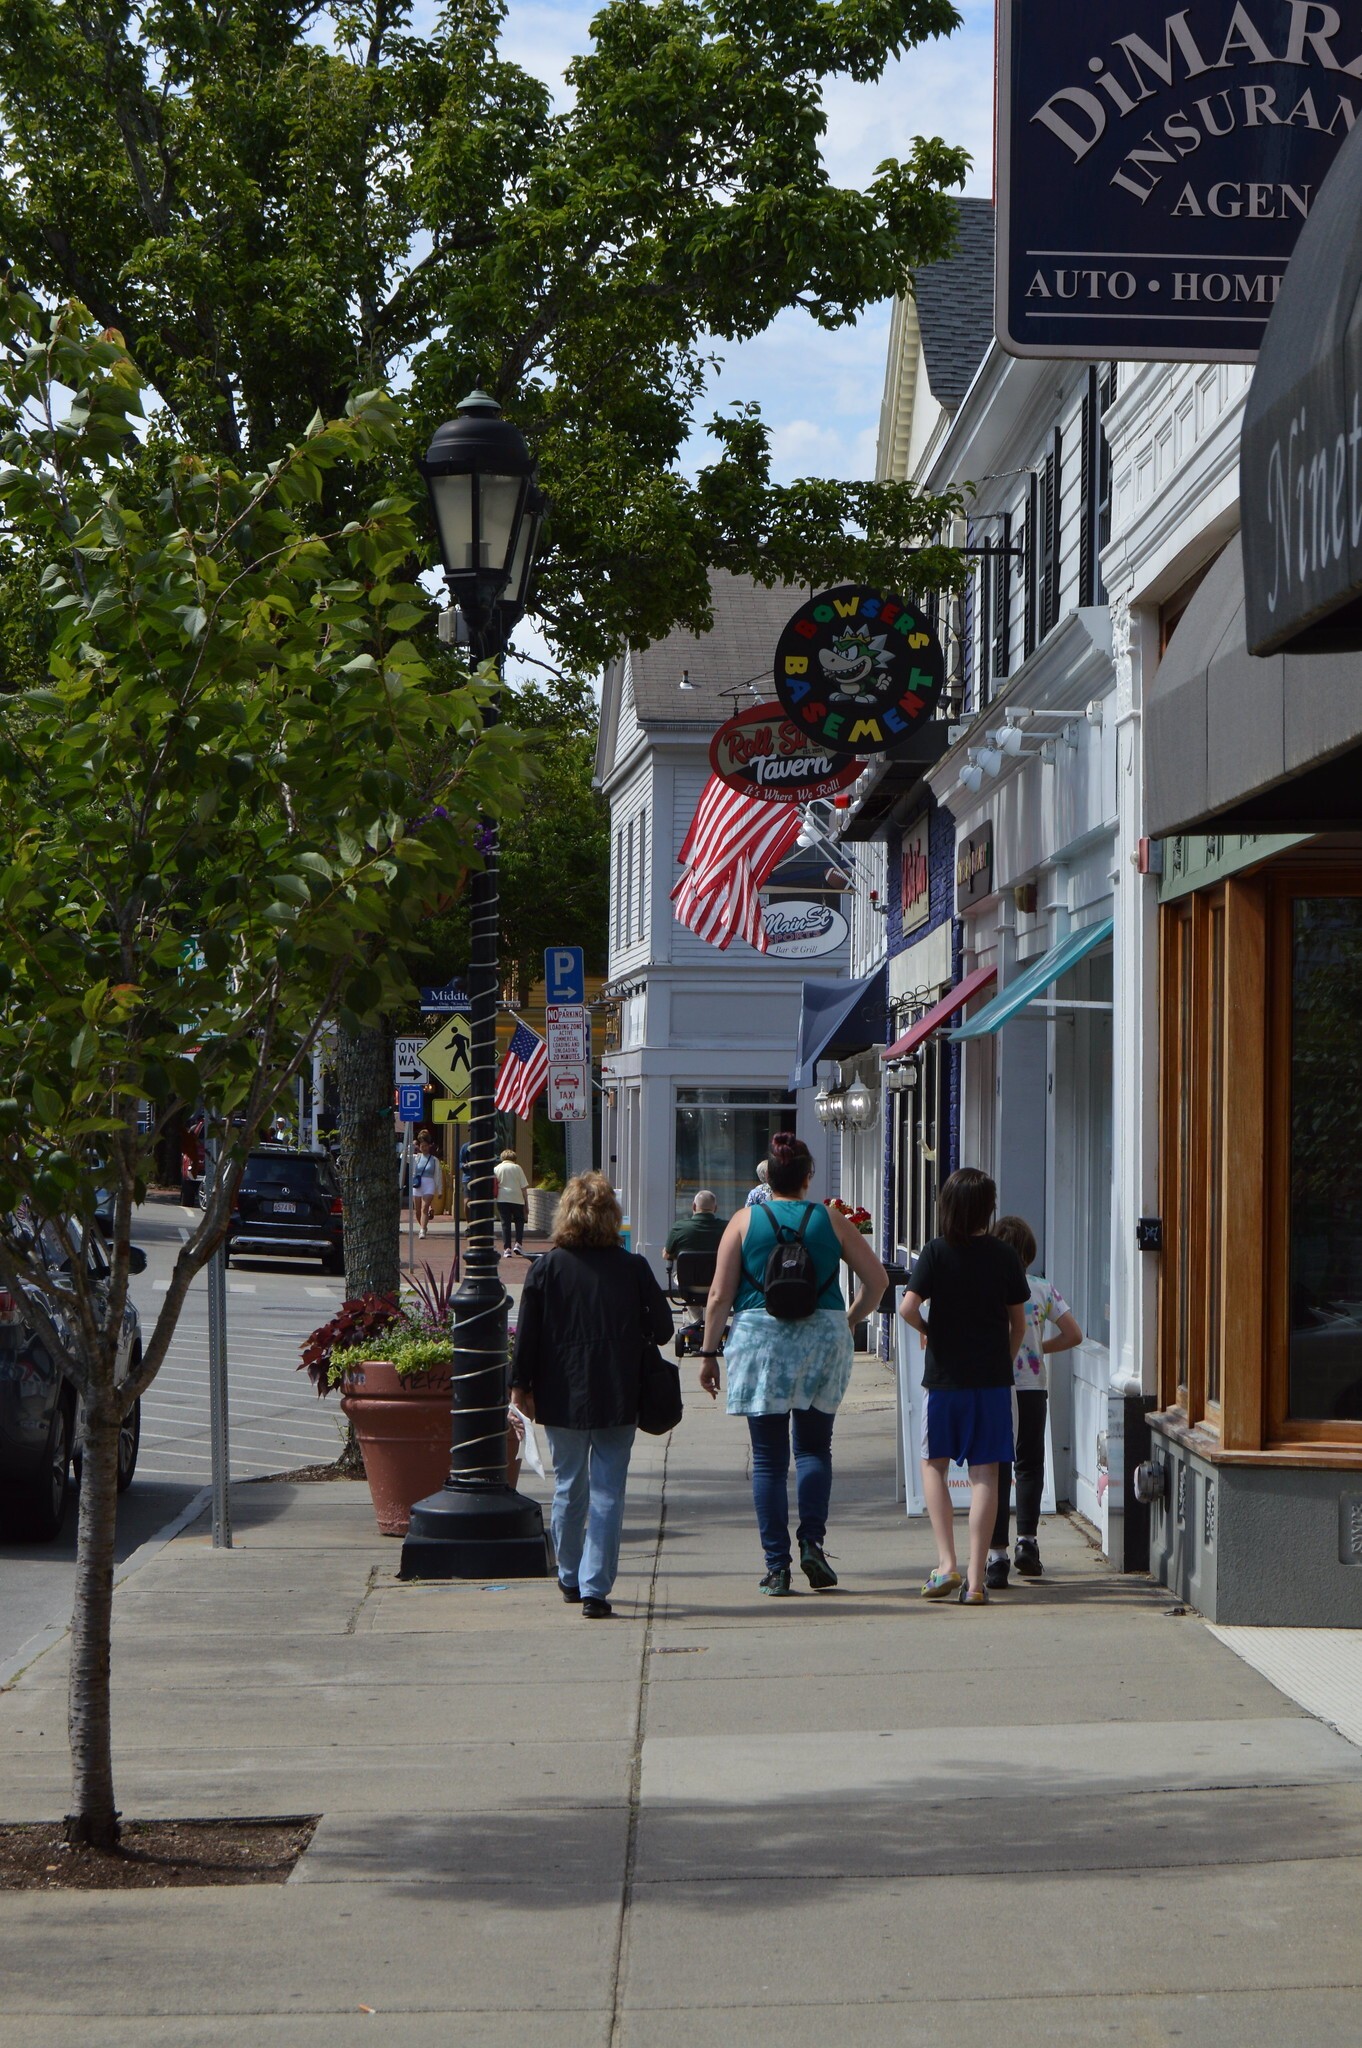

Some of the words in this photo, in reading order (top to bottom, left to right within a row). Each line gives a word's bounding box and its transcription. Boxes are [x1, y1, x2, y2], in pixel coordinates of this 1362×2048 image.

[1029, 0, 1362, 164] DiMAR
[1025, 269, 1137, 299] AUTO
[794, 597, 930, 649] BOWSERS
[785, 655, 934, 743] BASEMENT
[723, 726, 774, 764] Roll
[749, 754, 832, 785] Tavern
[744, 784, 760, 797] It's
[764, 789, 793, 802] Where
[796, 788, 813, 800] We
[816, 778, 840, 797] Roll!
[764, 912, 807, 935] Main
[807, 906, 832, 929] St
[768, 930, 822, 945] SPORTS
[775, 946, 789, 954] Bar
[553, 952, 575, 985] P
[548, 1010, 558, 1021] NO
[559, 1011, 583, 1019] PARKING
[406, 1093, 417, 1106] P
[560, 1091, 575, 1099] TAXI
